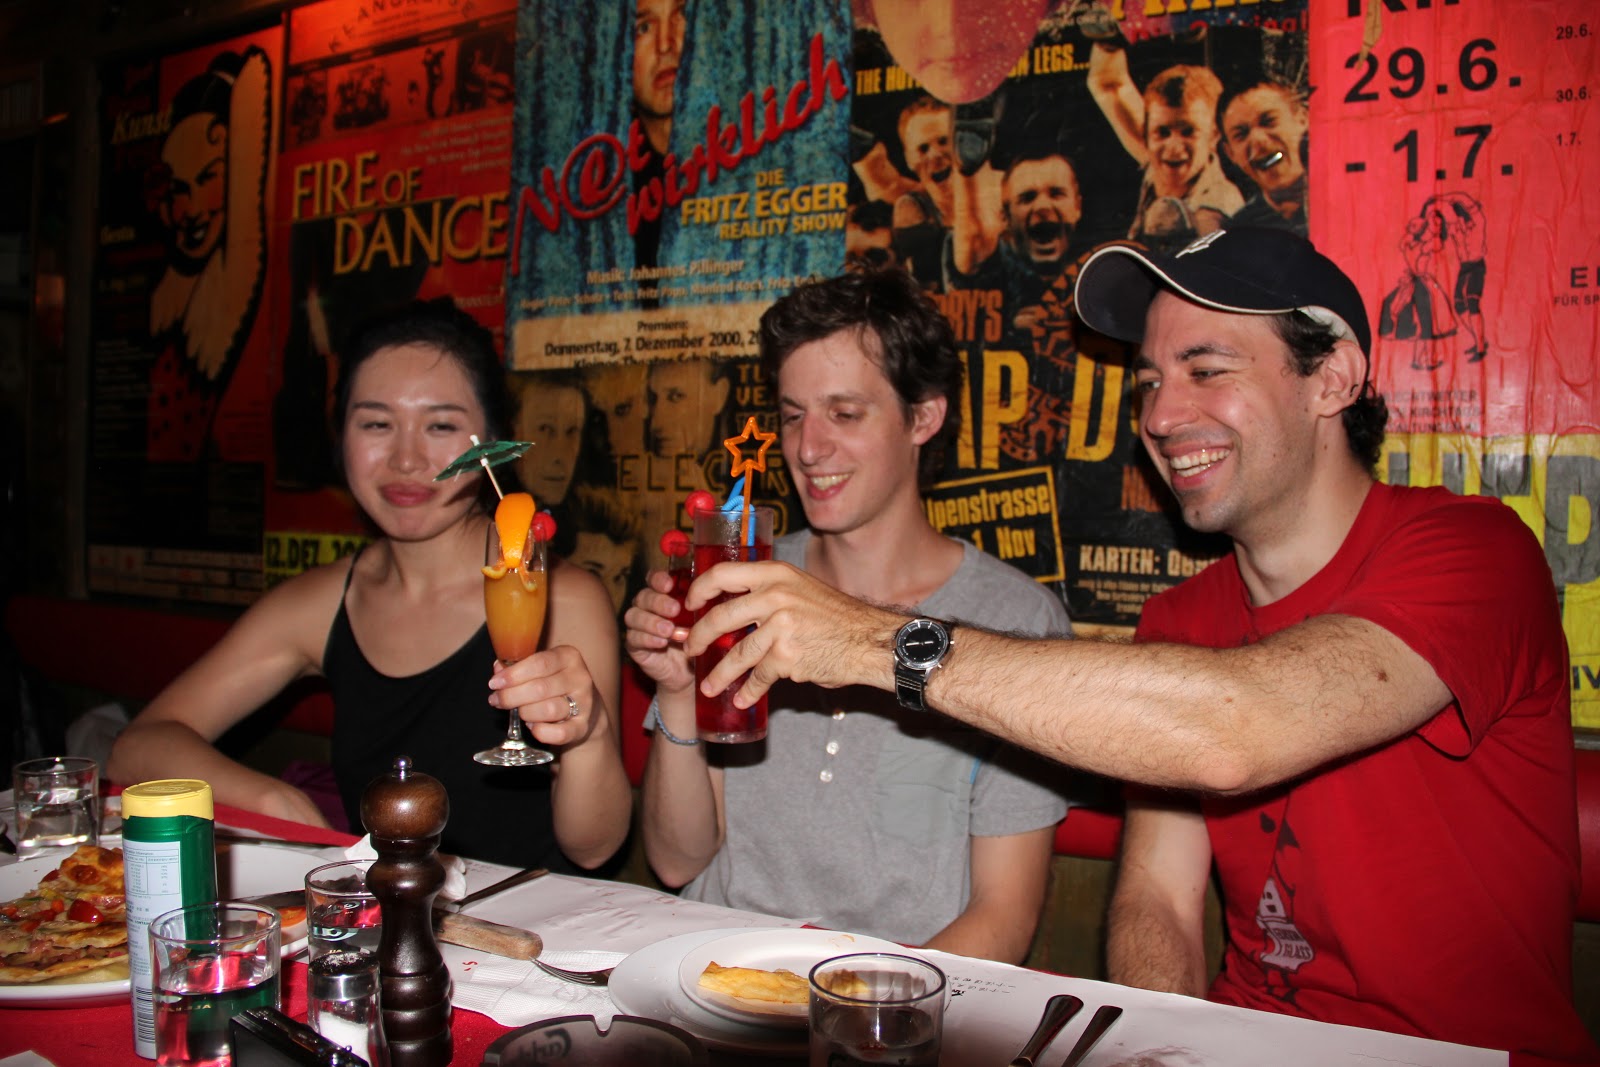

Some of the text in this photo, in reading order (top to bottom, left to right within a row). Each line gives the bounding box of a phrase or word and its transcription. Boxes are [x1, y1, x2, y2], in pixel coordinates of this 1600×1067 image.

[1553, 24, 1593, 40] 29.6.
[856, 68, 881, 96] THE
[1344, 39, 1522, 103] 29.6.
[1555, 88, 1592, 103] 30.6.
[626, 32, 849, 237] wirklich
[1556, 133, 1582, 147] 1.7.
[1393, 125, 1513, 182] 1.7.
[292, 149, 424, 220] FIRE OF
[755, 167, 785, 187] DIE
[680, 182, 849, 226] FRITZ EGGER
[333, 190, 509, 277] DANCE
[718, 211, 848, 241] REALITY SHOW
[629, 263, 687, 281] Johannes
[1570, 266, 1600, 289] E
[1554, 294, 1579, 306] FÜR
[637, 321, 689, 334] Premiere:
[544, 339, 620, 358] Donnerstag,
[635, 332, 704, 352] Dezember
[708, 331, 745, 349] 2000,
[619, 452, 790, 497] ELECR
[996, 526, 1037, 561] Nov
[1079, 544, 1161, 576] KARTEN:
